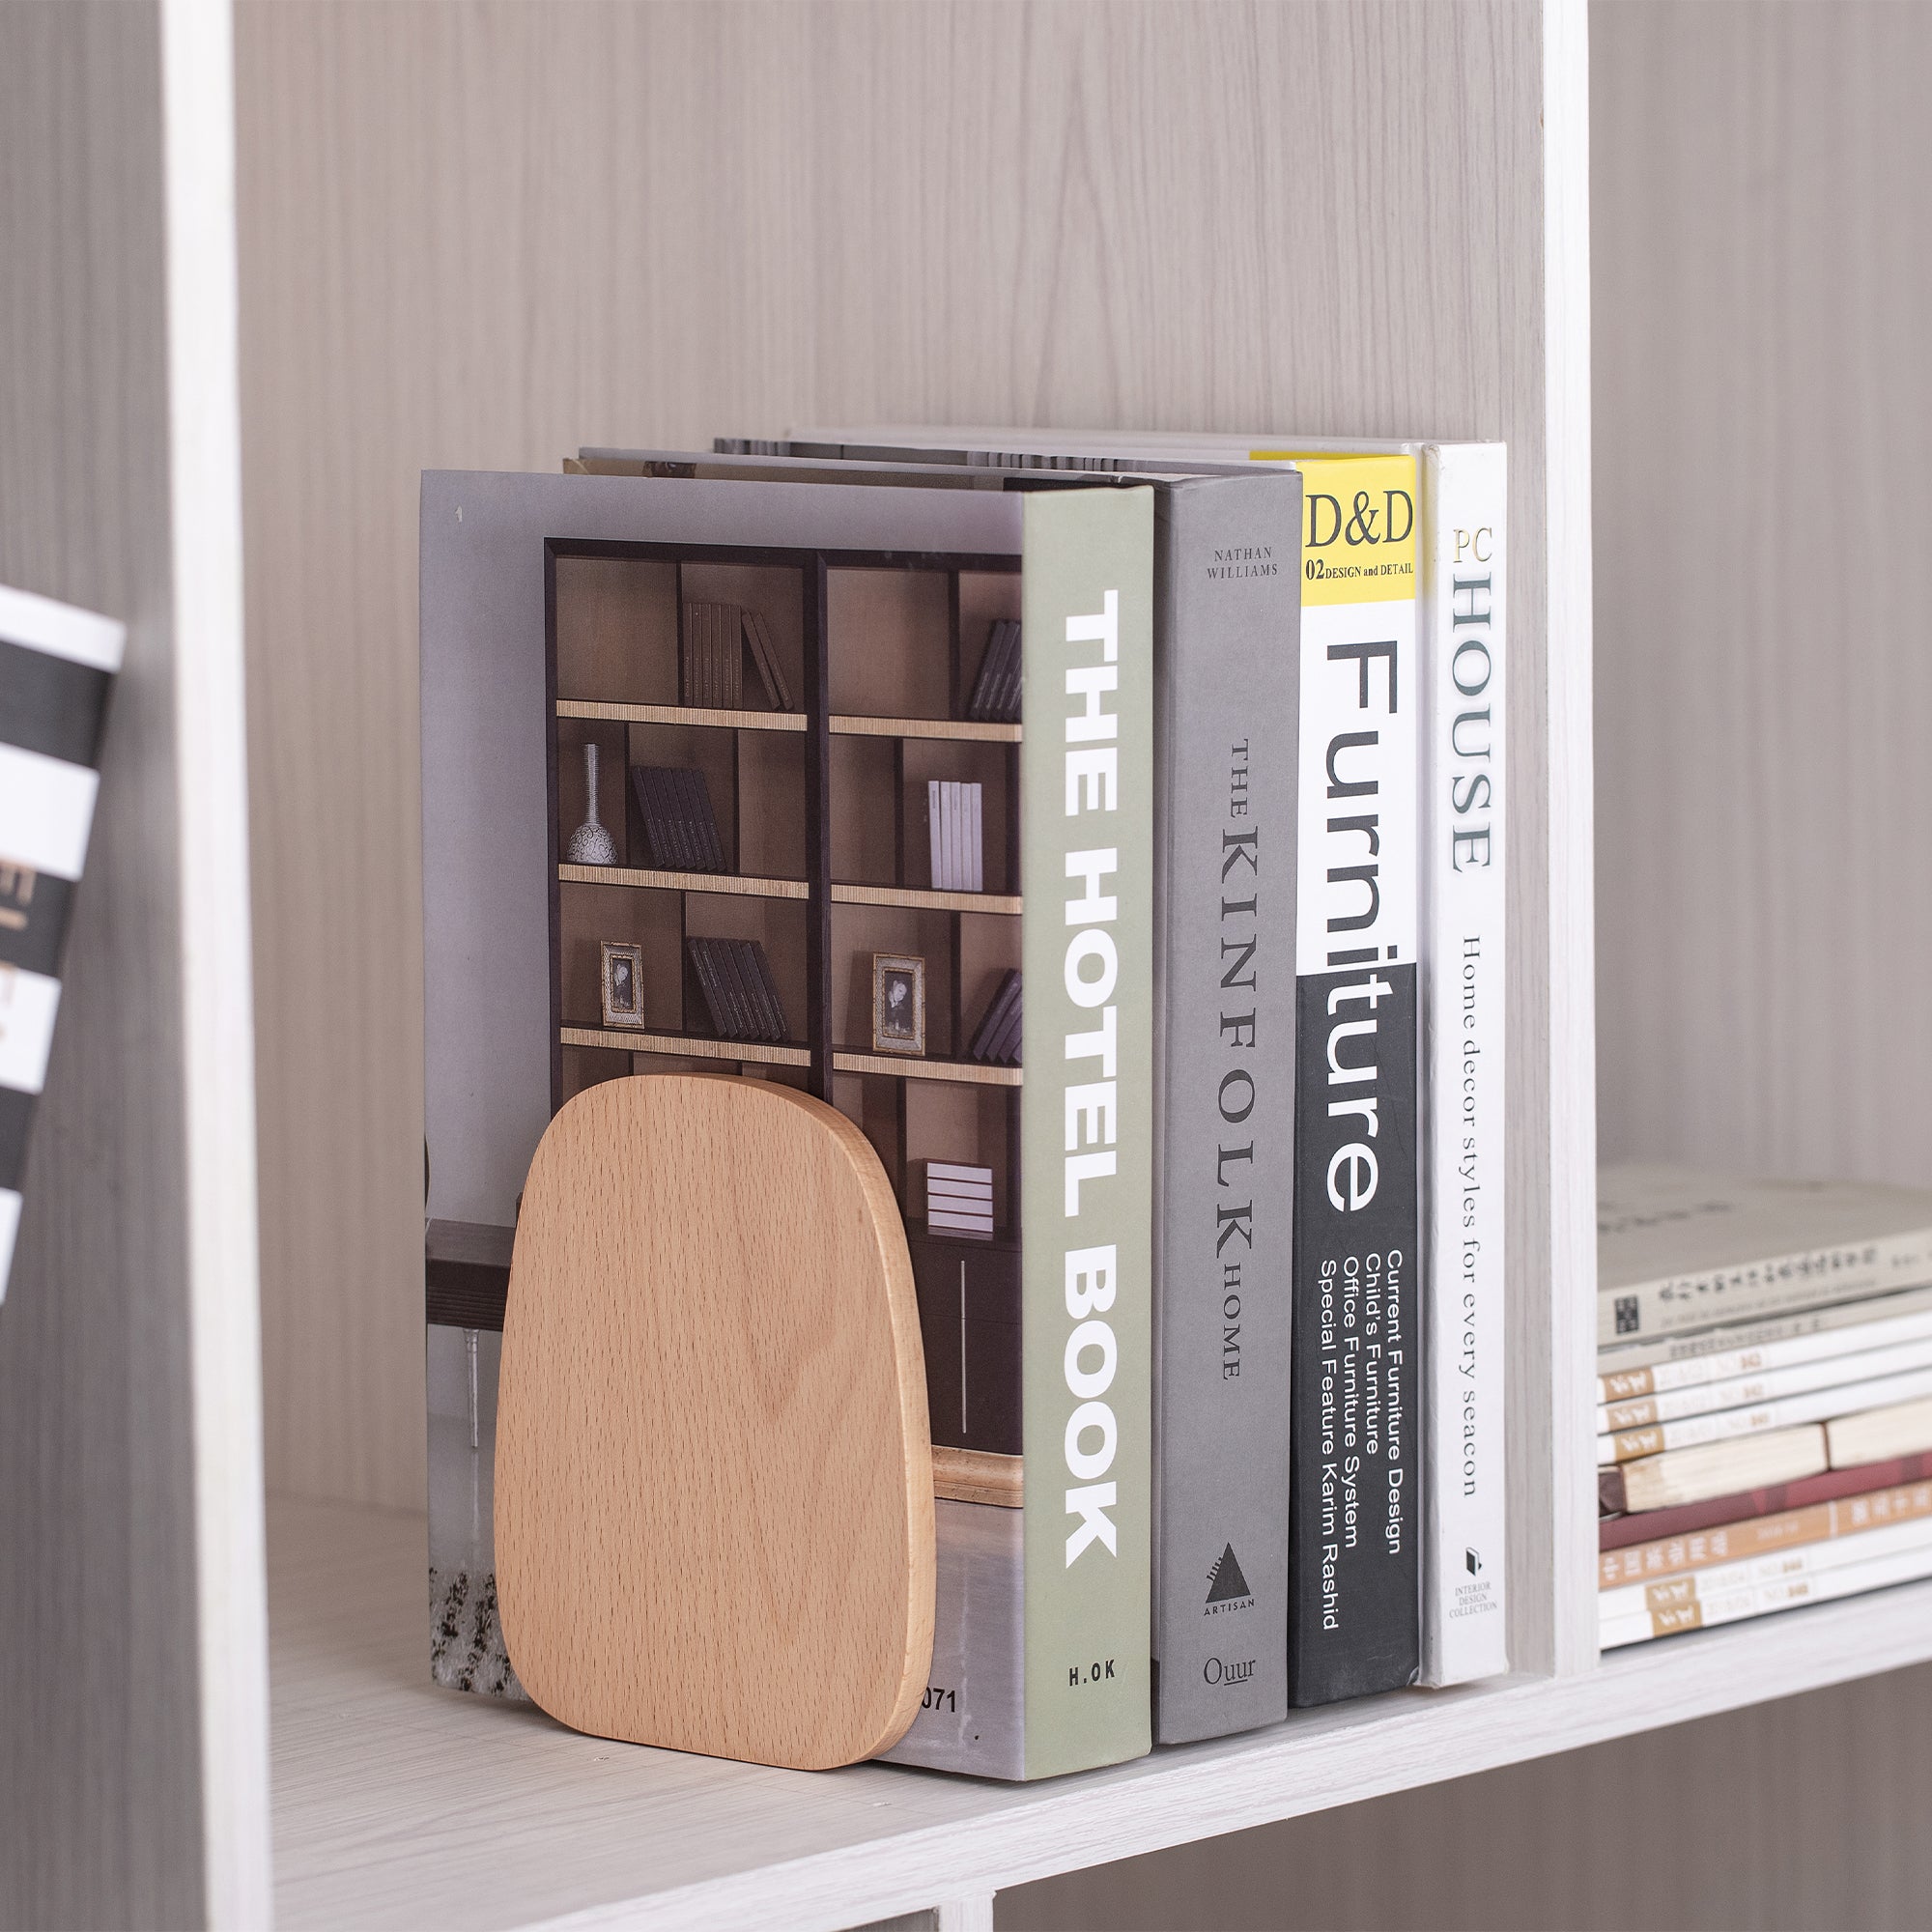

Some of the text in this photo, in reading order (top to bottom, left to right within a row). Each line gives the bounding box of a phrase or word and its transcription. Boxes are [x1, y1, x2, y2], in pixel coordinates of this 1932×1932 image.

[1304, 489, 1413, 548] D&D
[1453, 526, 1492, 564] PC
[1207, 563, 1278, 580] WILLIAMS
[1214, 546, 1272, 561] NATHAN
[1363, 565, 1378, 577] and
[1380, 562, 1414, 576] DETAIL
[1451, 572, 1492, 873] HOUSE
[1324, 639, 1399, 1213] Furniture
[1064, 589, 1119, 1569] THE HOTEL BOOK
[1215, 738, 1259, 1380] THE KINFOLK HOME
[1458, 937, 1481, 1496] Home decor styles for every seacon
[1341, 1256, 1360, 1548] Office Furniture System
[1366, 1343, 1381, 1455] Furniture
[1384, 1249, 1404, 1554] Current Furniture Design
[1318, 1260, 1339, 1631] Special Feature Karim Rashid
[1204, 1598, 1255, 1616] ARTISAN
[1449, 1601, 1497, 1618] COLLECTION
[1455, 1581, 1492, 1596] INTERIOR
[1459, 1593, 1487, 1606] DESIGN
[1203, 1657, 1257, 1687] Ouur
